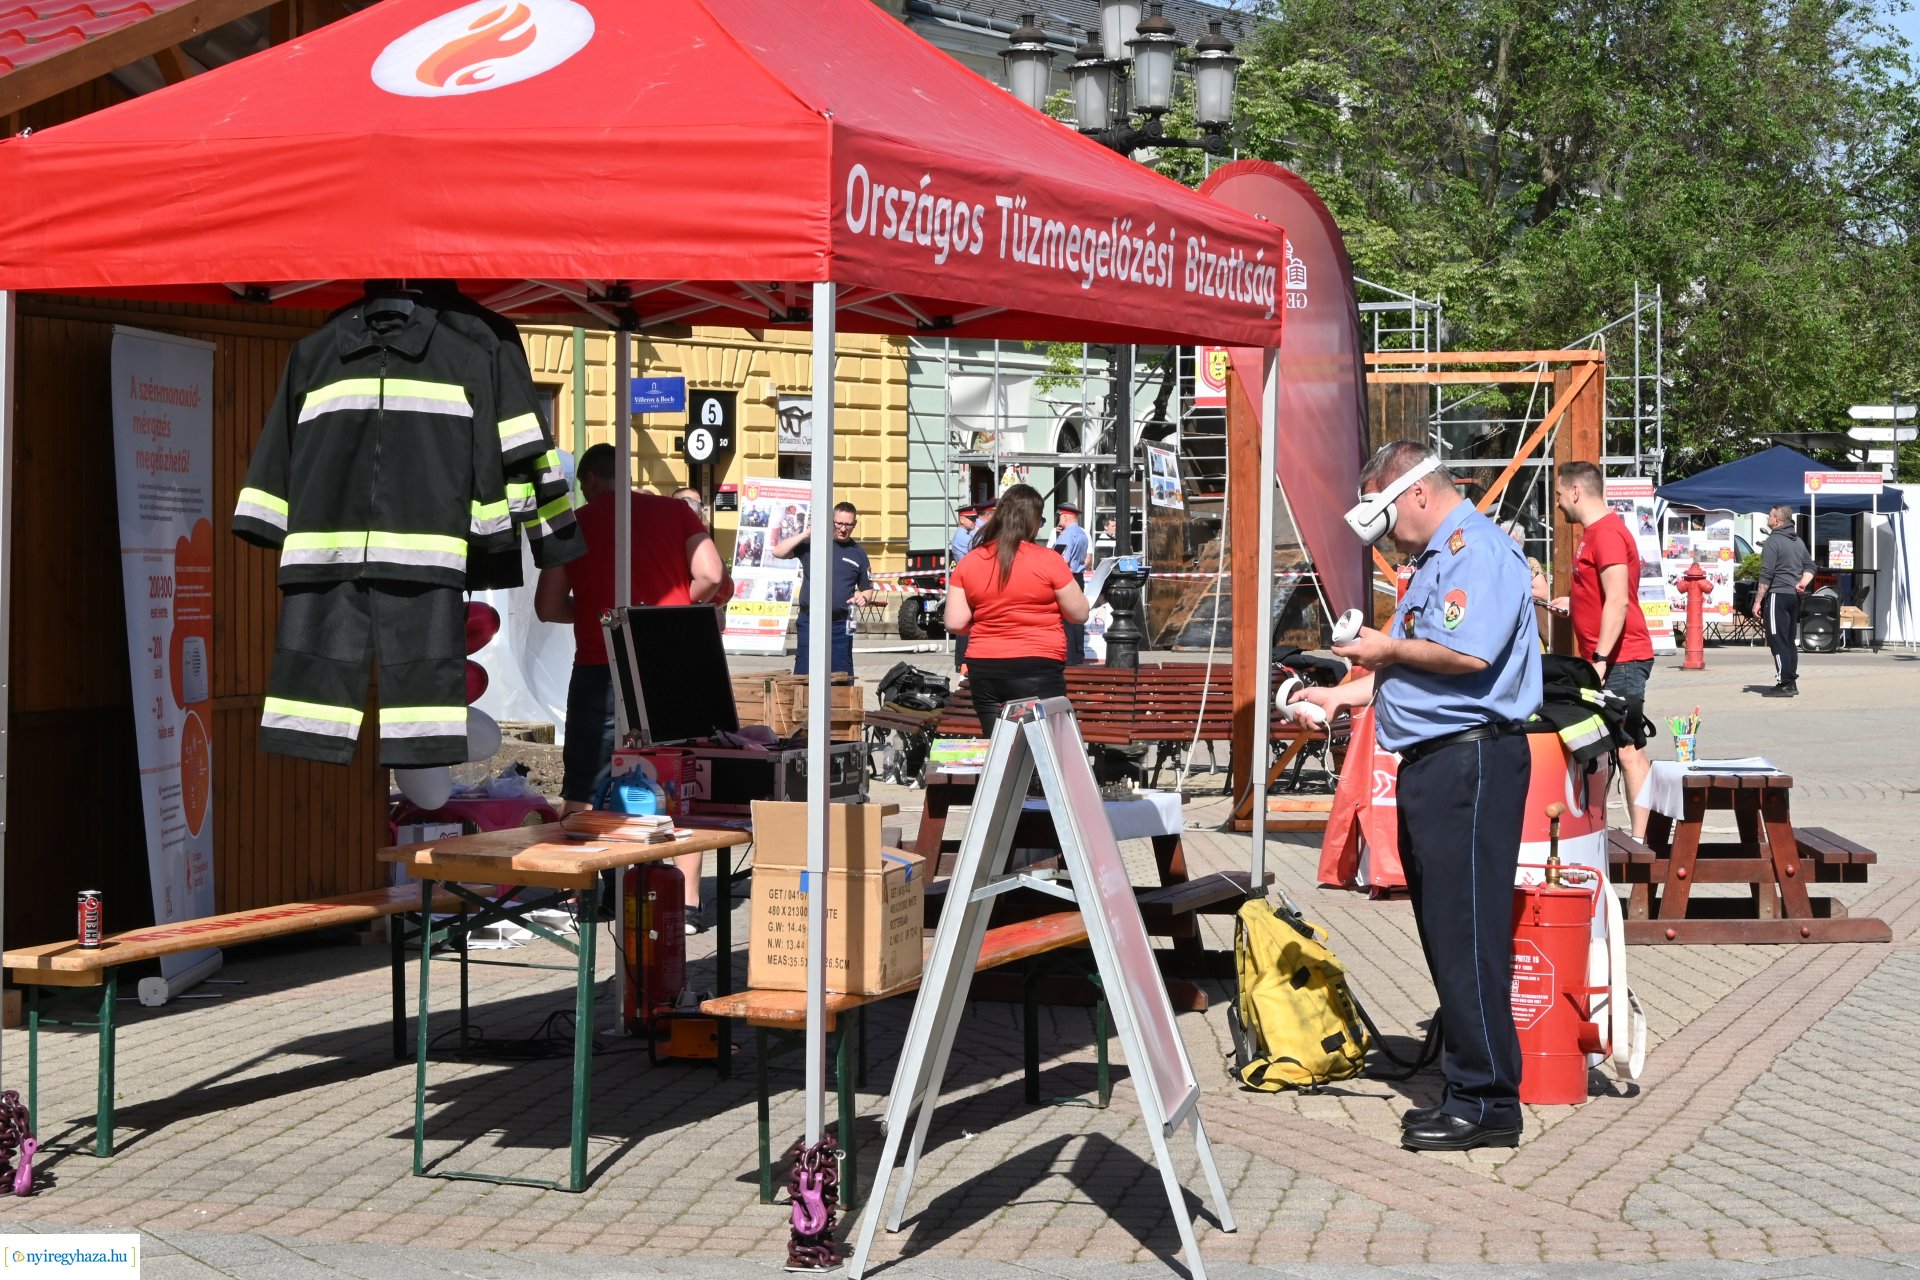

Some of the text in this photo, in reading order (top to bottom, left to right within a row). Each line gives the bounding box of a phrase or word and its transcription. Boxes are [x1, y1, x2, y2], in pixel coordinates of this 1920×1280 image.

[846, 163, 1277, 320] Országos Tűzmegelőzési Bizottság
[130, 375, 137, 400] A
[708, 403, 716, 424] 5
[696, 434, 705, 451] 5
[768, 905, 780, 916] 480
[768, 922, 807, 933] G.W: 14.49
[768, 938, 805, 950] N.W: 13.44
